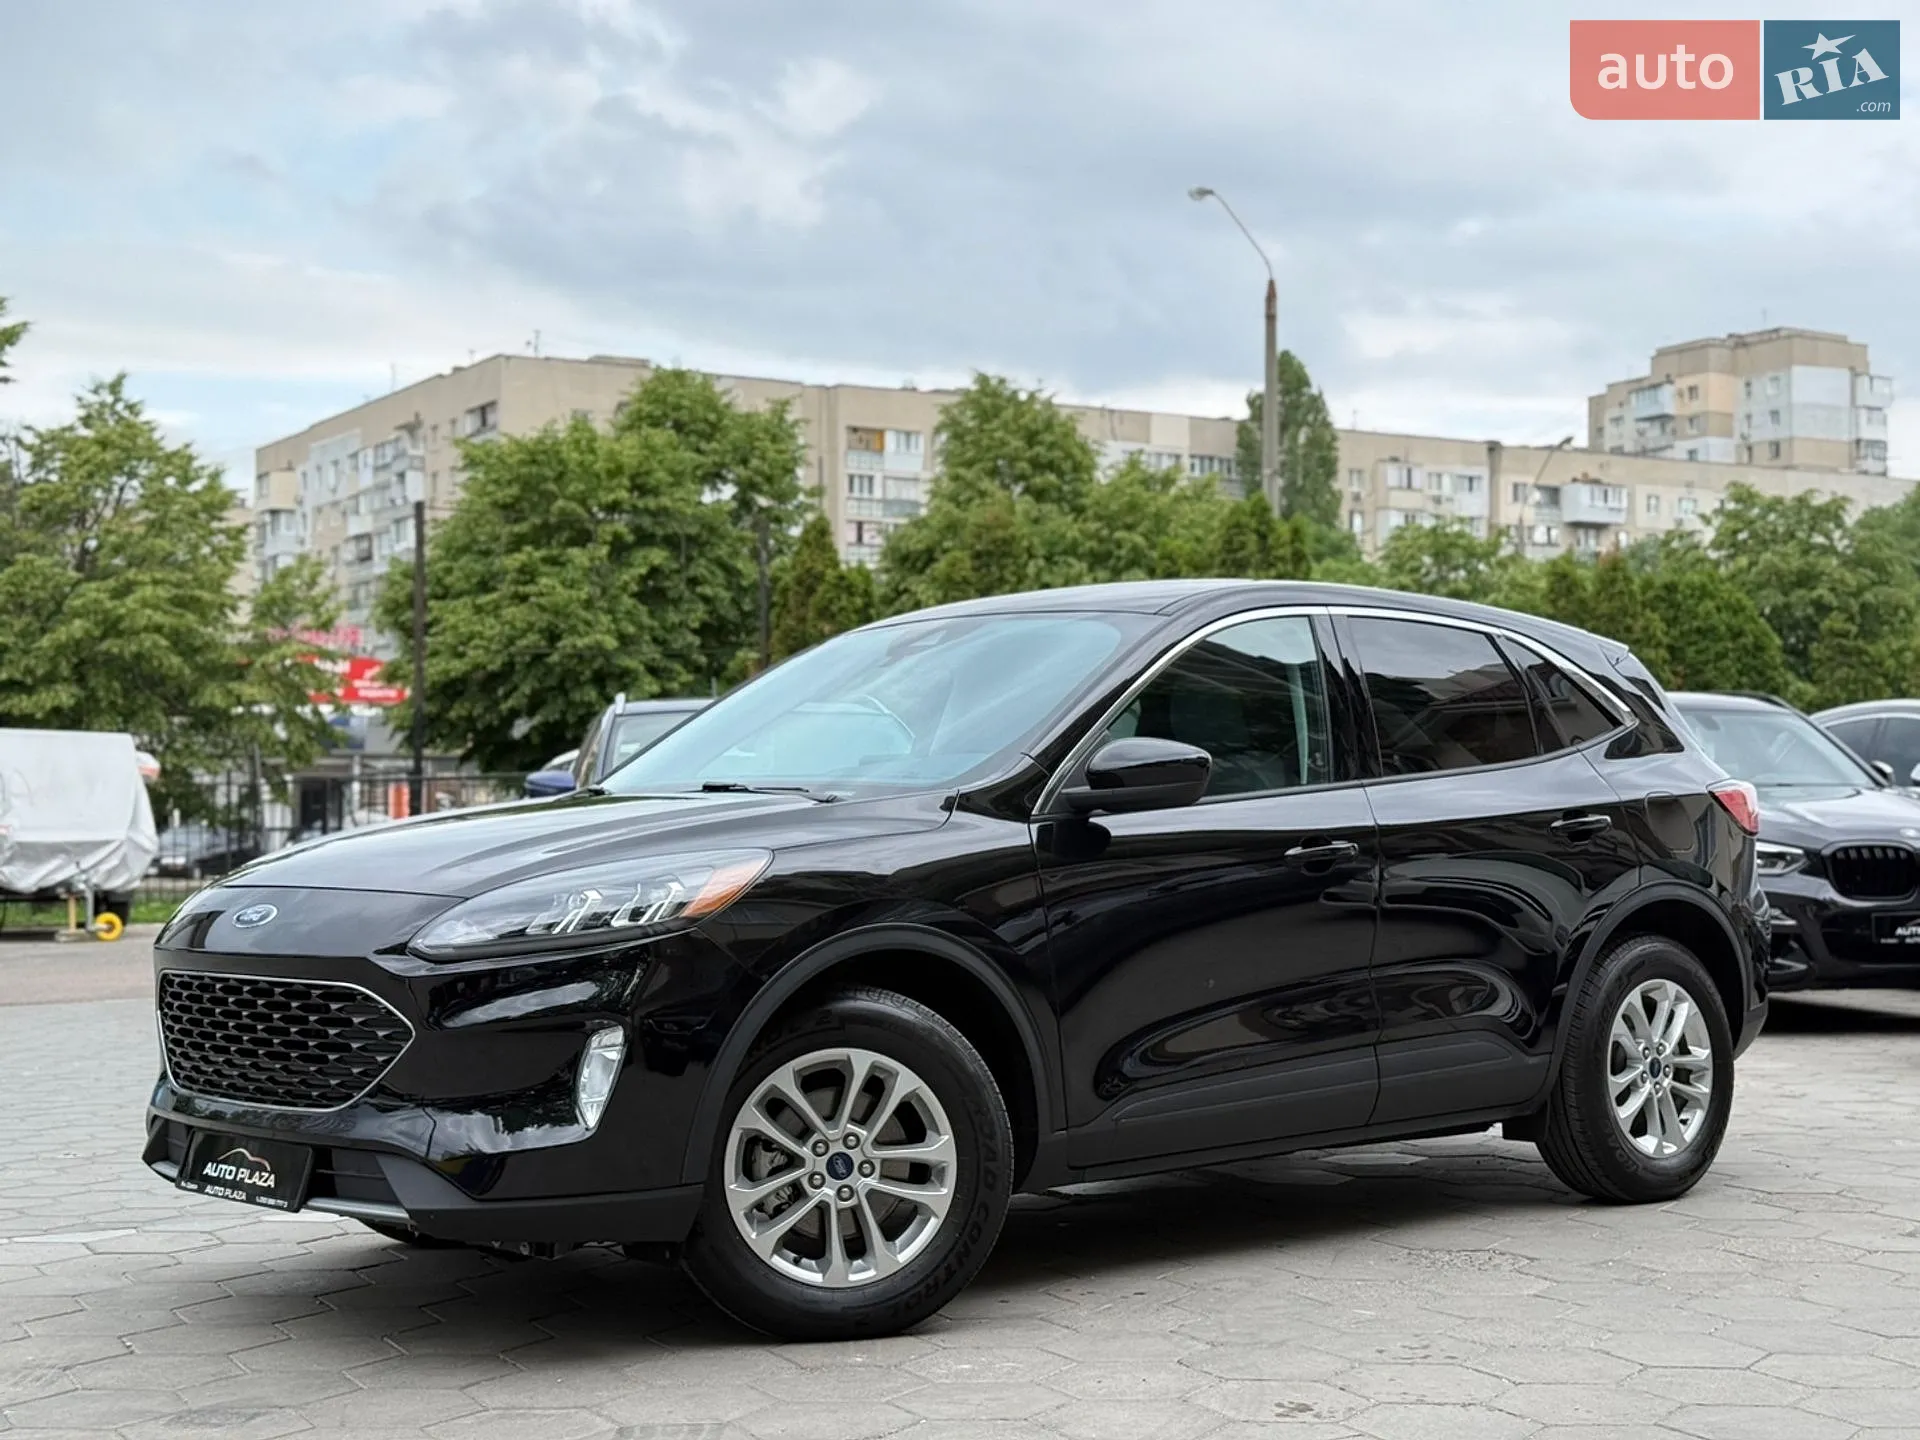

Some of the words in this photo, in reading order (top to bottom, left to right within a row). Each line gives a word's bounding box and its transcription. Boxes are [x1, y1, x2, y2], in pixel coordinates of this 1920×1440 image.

[203, 1162, 235, 1180] AUTO
[236, 1167, 276, 1188] PLAZA
[204, 1184, 224, 1197] AUTO
[224, 1187, 247, 1201] PLAZA
